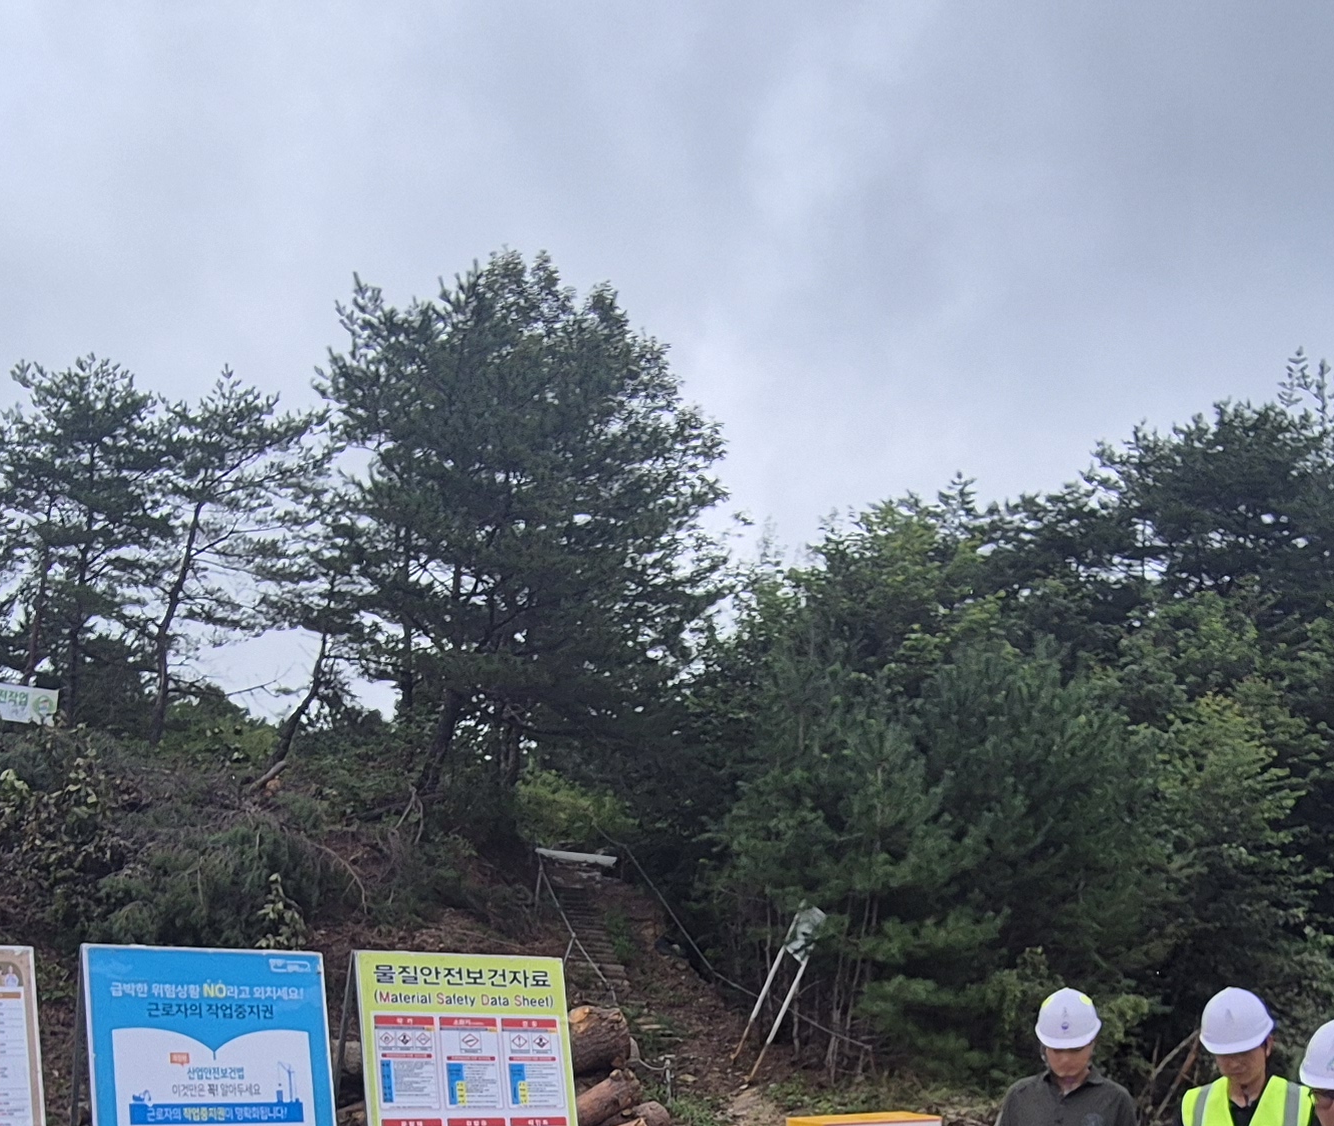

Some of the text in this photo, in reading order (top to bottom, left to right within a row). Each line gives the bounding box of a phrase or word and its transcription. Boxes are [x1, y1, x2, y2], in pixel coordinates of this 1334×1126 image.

[373, 964, 552, 988] 물질안전보건자료
[110, 981, 148, 998] 급박한
[151, 982, 200, 999] 위험상황
[253, 986, 304, 1000] 외치세요!
[374, 991, 554, 1008] (Material Safety Data Sheet)
[147, 1002, 275, 1020] 근로자의 작업중지권
[187, 1066, 245, 1081] 산업안전보건법
[172, 1084, 205, 1097] 이것만은
[220, 1083, 261, 1097] 알아두세요
[147, 1107, 182, 1121] 근로자의
